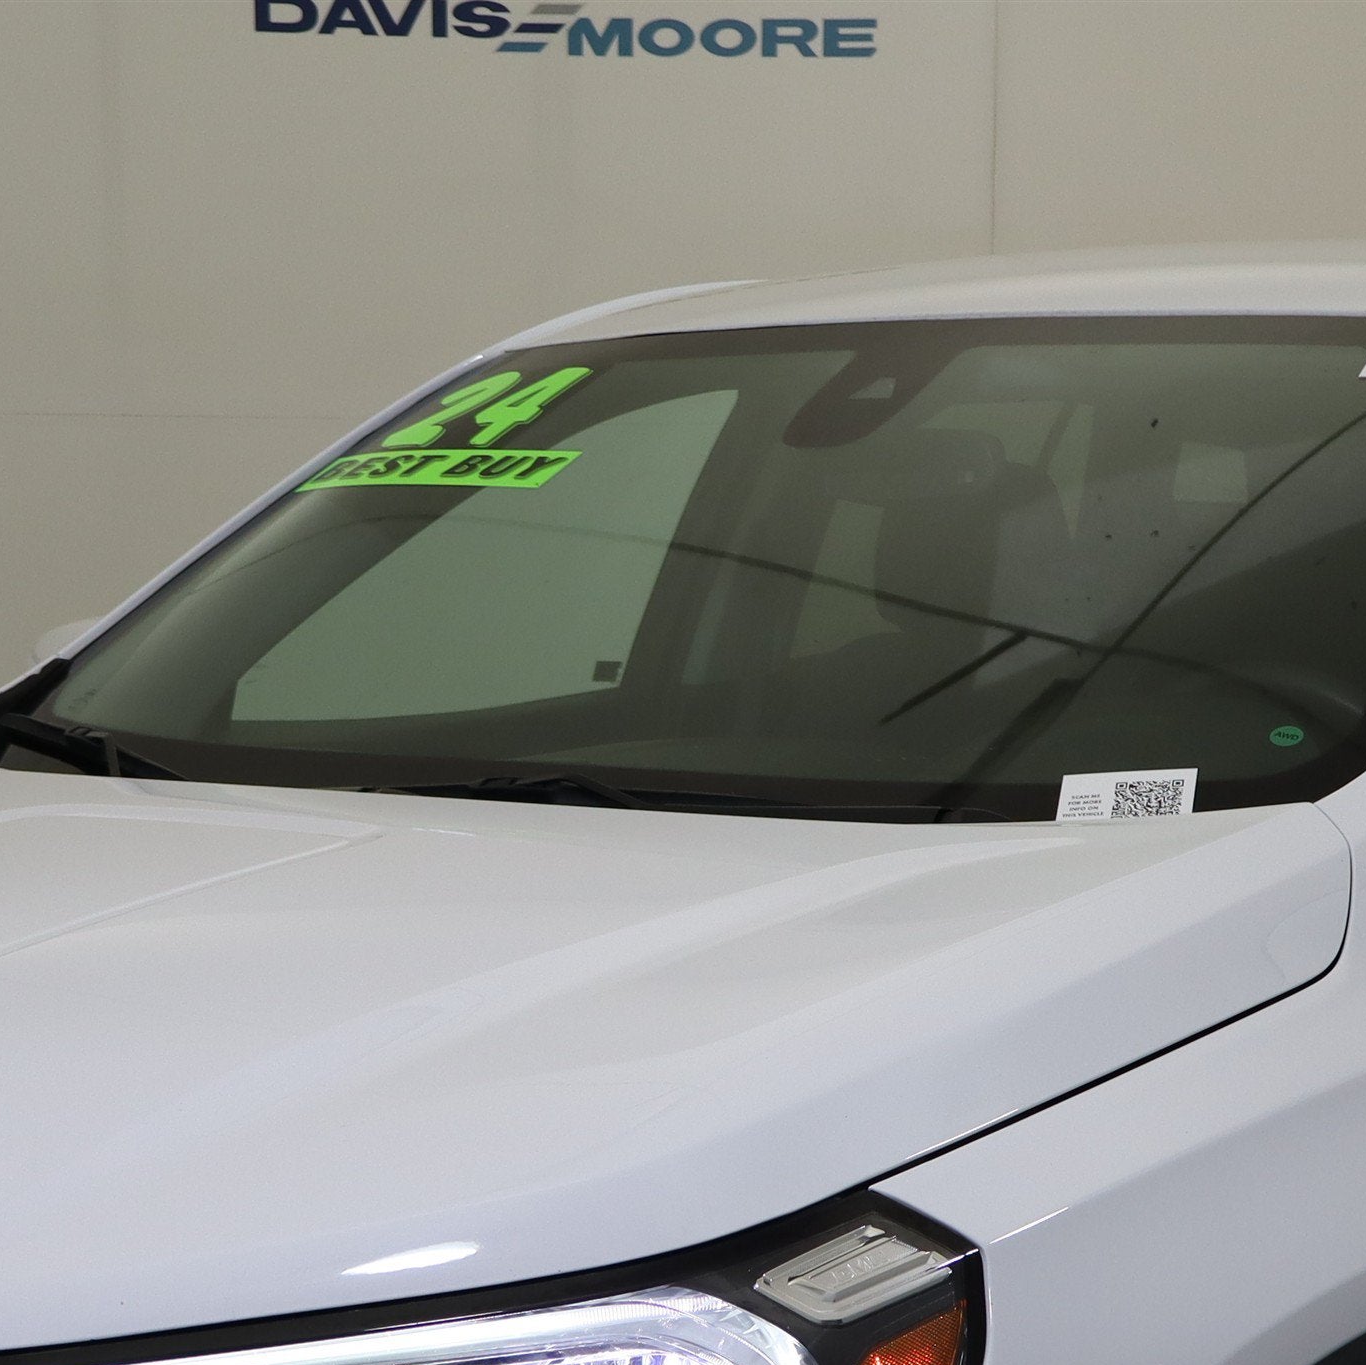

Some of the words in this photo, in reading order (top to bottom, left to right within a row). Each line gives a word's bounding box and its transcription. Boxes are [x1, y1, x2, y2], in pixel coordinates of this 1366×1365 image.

[253, 0, 514, 37] DAVIS
[567, 18, 878, 58] MOORE
[381, 367, 593, 448] 24
[310, 454, 450, 482] BEST
[440, 454, 570, 480] BUY
